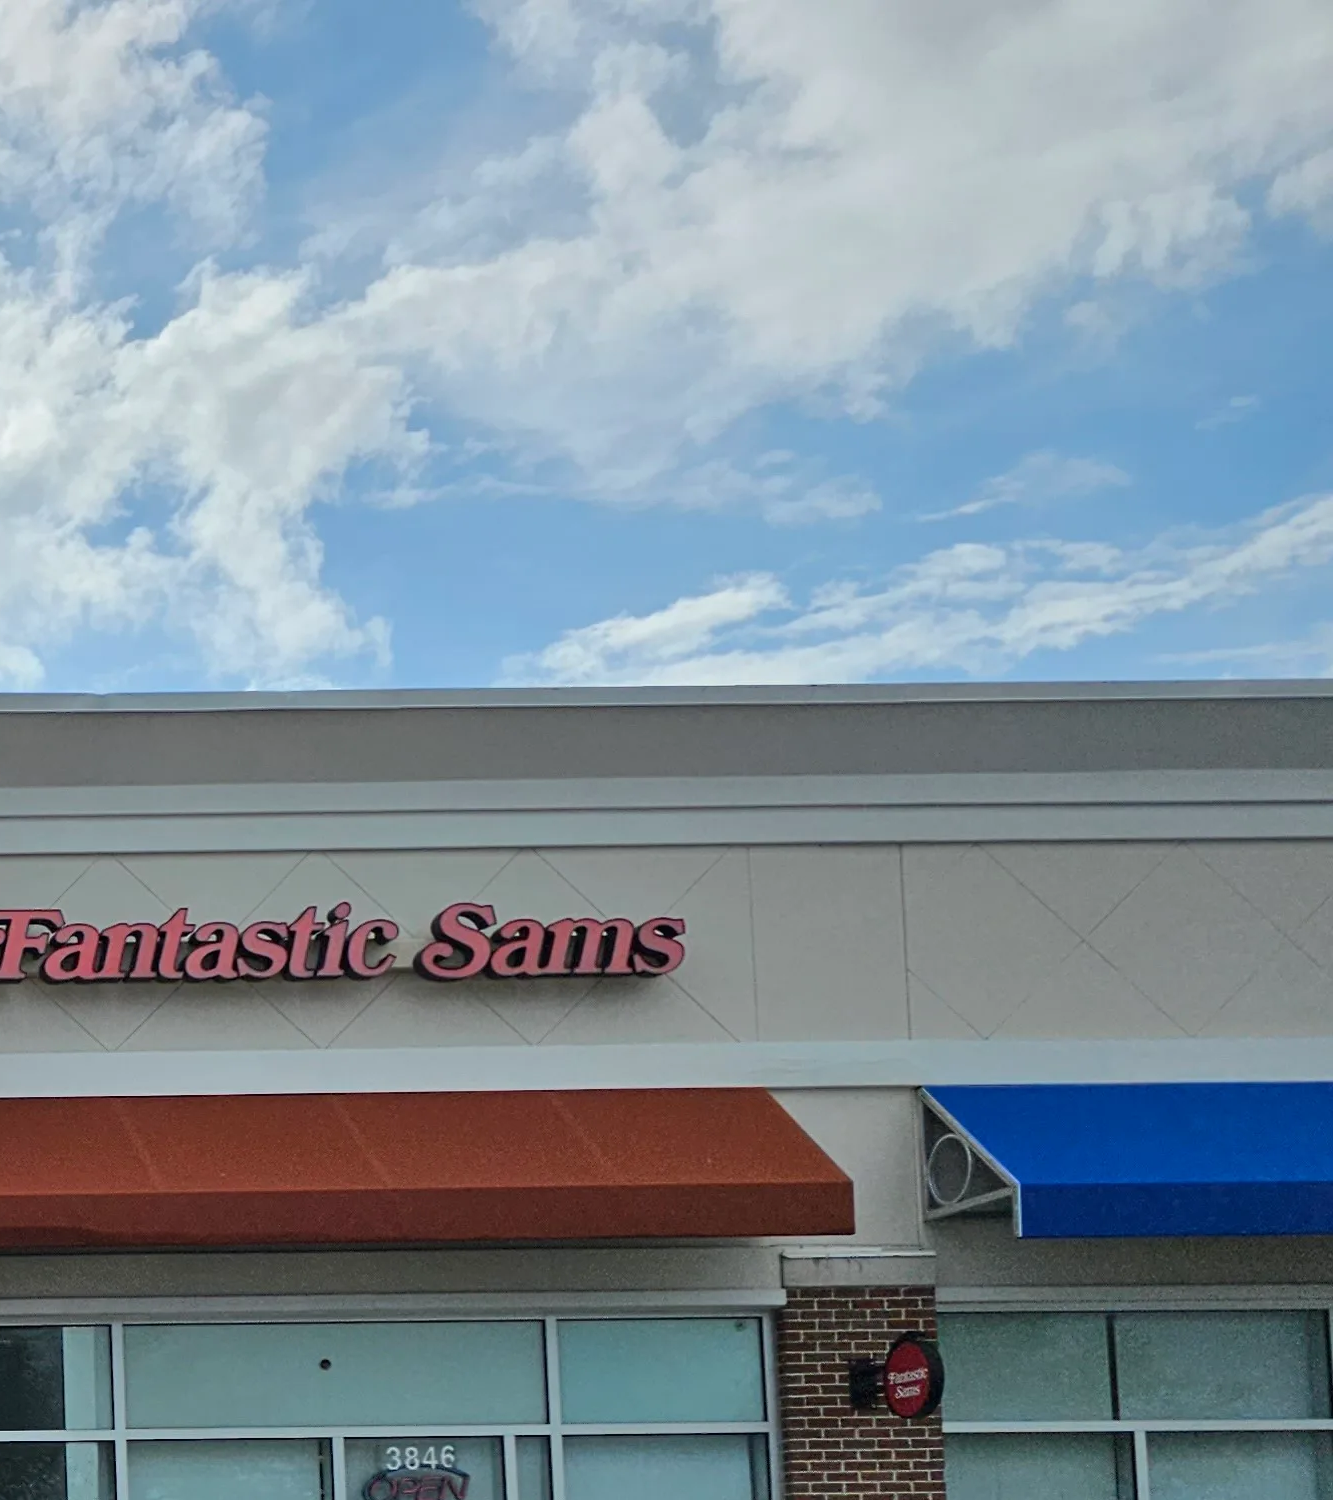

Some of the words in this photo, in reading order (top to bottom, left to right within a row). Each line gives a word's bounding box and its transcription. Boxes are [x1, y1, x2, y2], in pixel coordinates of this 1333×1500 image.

[414, 902, 686, 981] Sams
[887, 1366, 929, 1385] Fantastic
[894, 1385, 921, 1399] Sams
[386, 1445, 455, 1470] 3846
